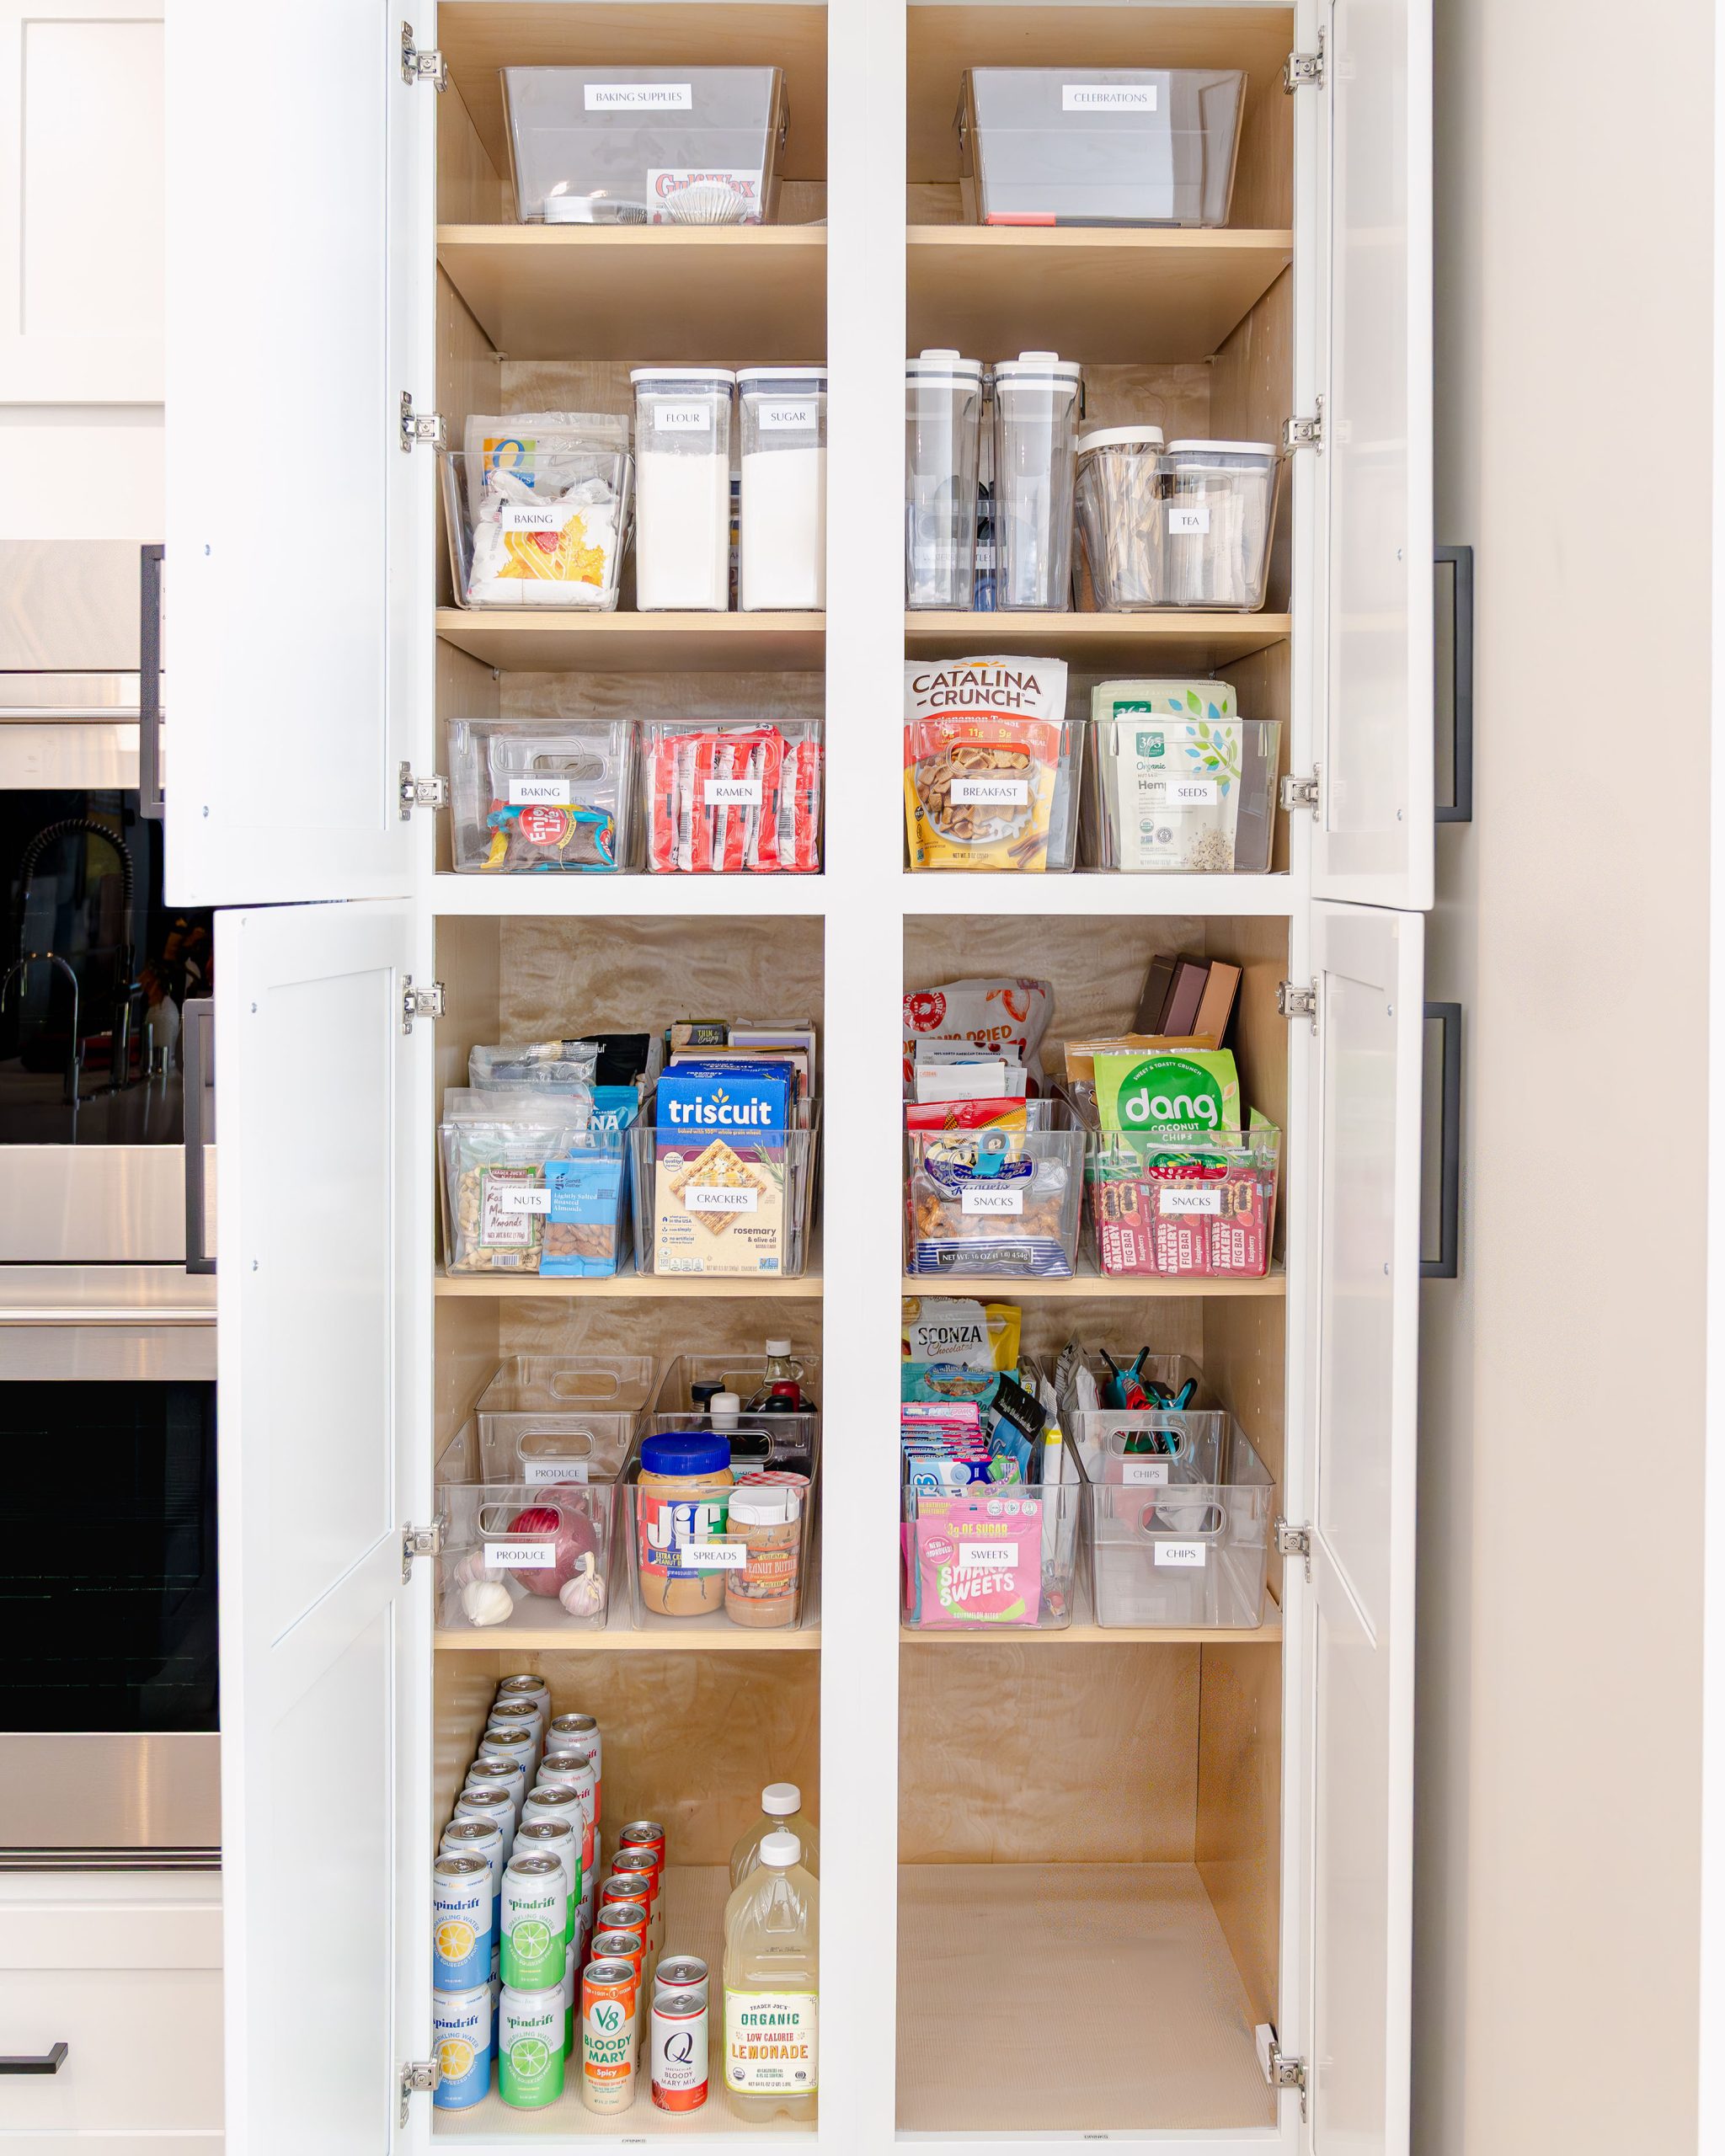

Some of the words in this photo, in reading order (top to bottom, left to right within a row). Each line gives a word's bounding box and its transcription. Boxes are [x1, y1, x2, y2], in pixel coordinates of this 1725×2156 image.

[596, 93, 634, 102] BAKING
[638, 93, 682, 102] SUPPLIES
[1074, 93, 1148, 103] CELEBRATIONS
[666, 414, 700, 424] FLOUR
[771, 412, 807, 422] SUGAR
[515, 515, 553, 524] BAKING
[1182, 516, 1199, 526] TEA
[912, 670, 1041, 696] CATALINA
[930, 689, 1021, 708] CRUNCH
[969, 728, 984, 739] 11g
[1140, 735, 1162, 749] 365
[1136, 761, 1167, 772] Organic
[521, 787, 560, 797] BAKING
[716, 787, 752, 797] RAMEN
[963, 787, 1018, 797] BREAKFAST
[1139, 780, 1166, 792] Hem
[1178, 787, 1208, 798] SEEDS
[528, 806, 549, 842] Enjoy
[698, 1035, 719, 1044] Crispy
[966, 1025, 1012, 1042] DRIED
[1133, 1067, 1149, 1081] SWEET
[1178, 1063, 1202, 1076] CRUNCH
[669, 1097, 772, 1125] triscuit
[1125, 1087, 1218, 1128] dang
[1151, 1123, 1199, 1132] COCONUT
[1162, 1134, 1193, 1142] CHIPS
[514, 1196, 542, 1205] NUTS
[554, 1193, 575, 1201] Lightly
[697, 1193, 748, 1204] CRACKERS
[974, 1197, 1013, 1207] SNACKS
[1172, 1197, 1211, 1206] SNACKS
[491, 1217, 522, 1227] Almonds
[734, 1227, 777, 1235] rosemary
[1124, 1232, 1133, 1249] BAR
[1181, 1233, 1189, 1249] BAR
[1220, 1222, 1231, 1269] BAKERY
[1108, 1225, 1122, 1271] BAKERY
[1167, 1224, 1178, 1273] BAKERY
[1247, 1235, 1256, 1262] Raspberry
[1012, 1252, 1028, 1261] 454g
[1124, 1250, 1134, 1263] FIG
[1181, 1251, 1190, 1266] FIG
[919, 1326, 983, 1345] SCONZA
[927, 1342, 973, 1357] Chocolates
[536, 1469, 579, 1478] PRODUCE
[1133, 1470, 1160, 1479] CHIPS
[647, 1503, 721, 1550] Jif
[948, 1522, 959, 1538] 3g
[962, 1524, 973, 1534] OF
[976, 1523, 1008, 1537] SUGAR
[929, 1541, 943, 1550] NEW
[496, 1550, 546, 1561] PRODUCE
[655, 1551, 671, 1560] EXTRA
[693, 1551, 737, 1561] SPREADS
[970, 1550, 1009, 1560] SWEETS
[1166, 1549, 1197, 1559] CHIPS
[655, 1557, 676, 1566] PEANUT
[940, 1572, 1015, 1607] SWEETS
[433, 1897, 480, 1911] spindrift
[508, 1897, 556, 1911] spindrift
[463, 1915, 480, 1931] WATER
[539, 1914, 555, 1930] WATER
[441, 1956, 468, 1968] SQUEEZED
[467, 1944, 478, 1961] FRUIT
[506, 2014, 554, 2029] spindrift
[595, 2005, 619, 2031] V8
[741, 2013, 800, 2025] ORGANIC
[462, 2033, 479, 2048] WATER
[537, 2031, 553, 2047] WATER
[585, 2034, 632, 2051] BLOODY
[746, 2033, 762, 2041] LOW
[764, 2032, 794, 2041] CALORIE
[664, 2031, 693, 2064] Q
[731, 2042, 809, 2059] LEMONADE
[589, 2050, 627, 2063] MARY
[596, 2068, 617, 2078] Spicy
